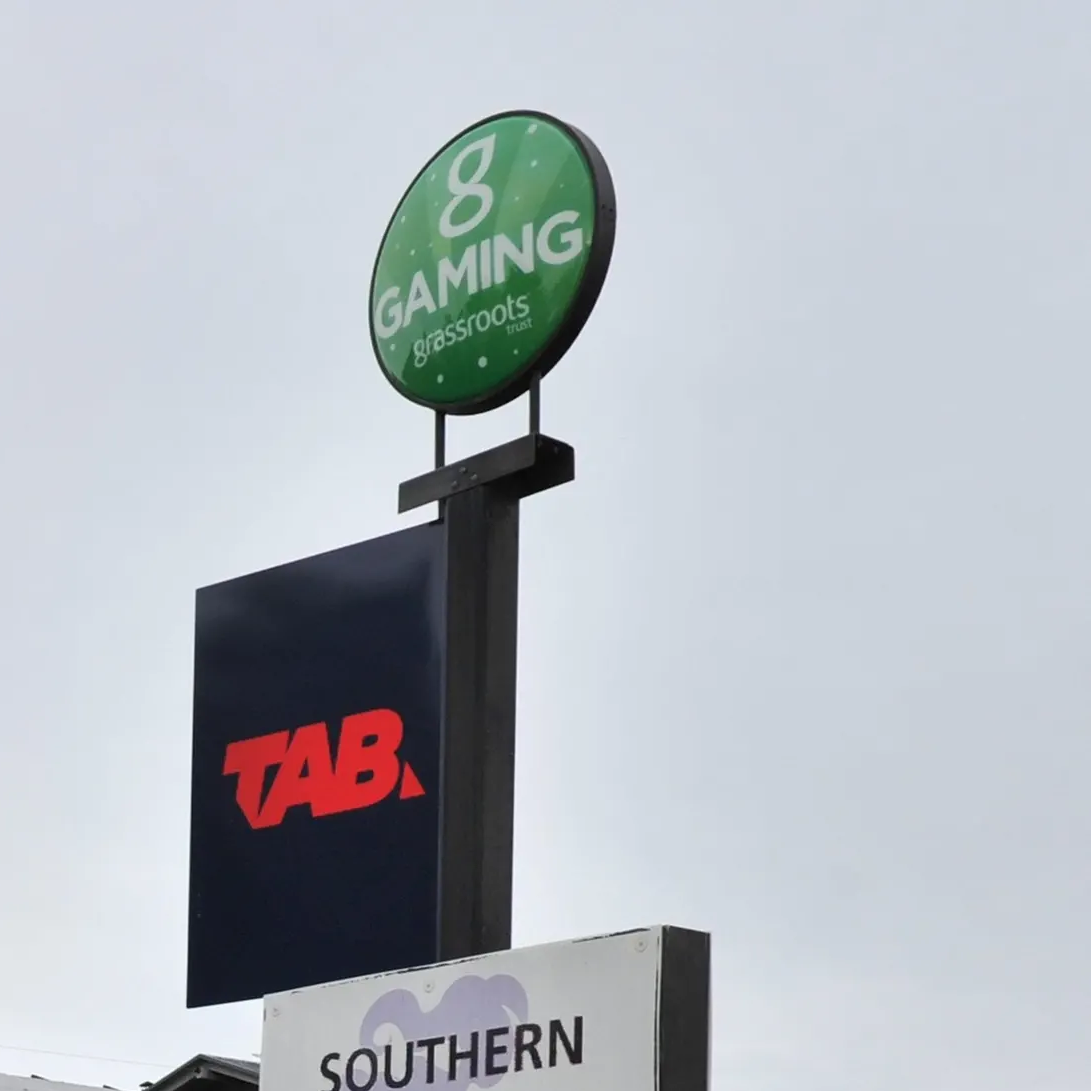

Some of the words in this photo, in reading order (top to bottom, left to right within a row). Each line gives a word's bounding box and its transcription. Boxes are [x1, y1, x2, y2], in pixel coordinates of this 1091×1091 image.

[374, 210, 583, 339] GAMING
[413, 294, 530, 368] grassroots
[506, 318, 533, 335] trust
[222, 708, 405, 830] TAB
